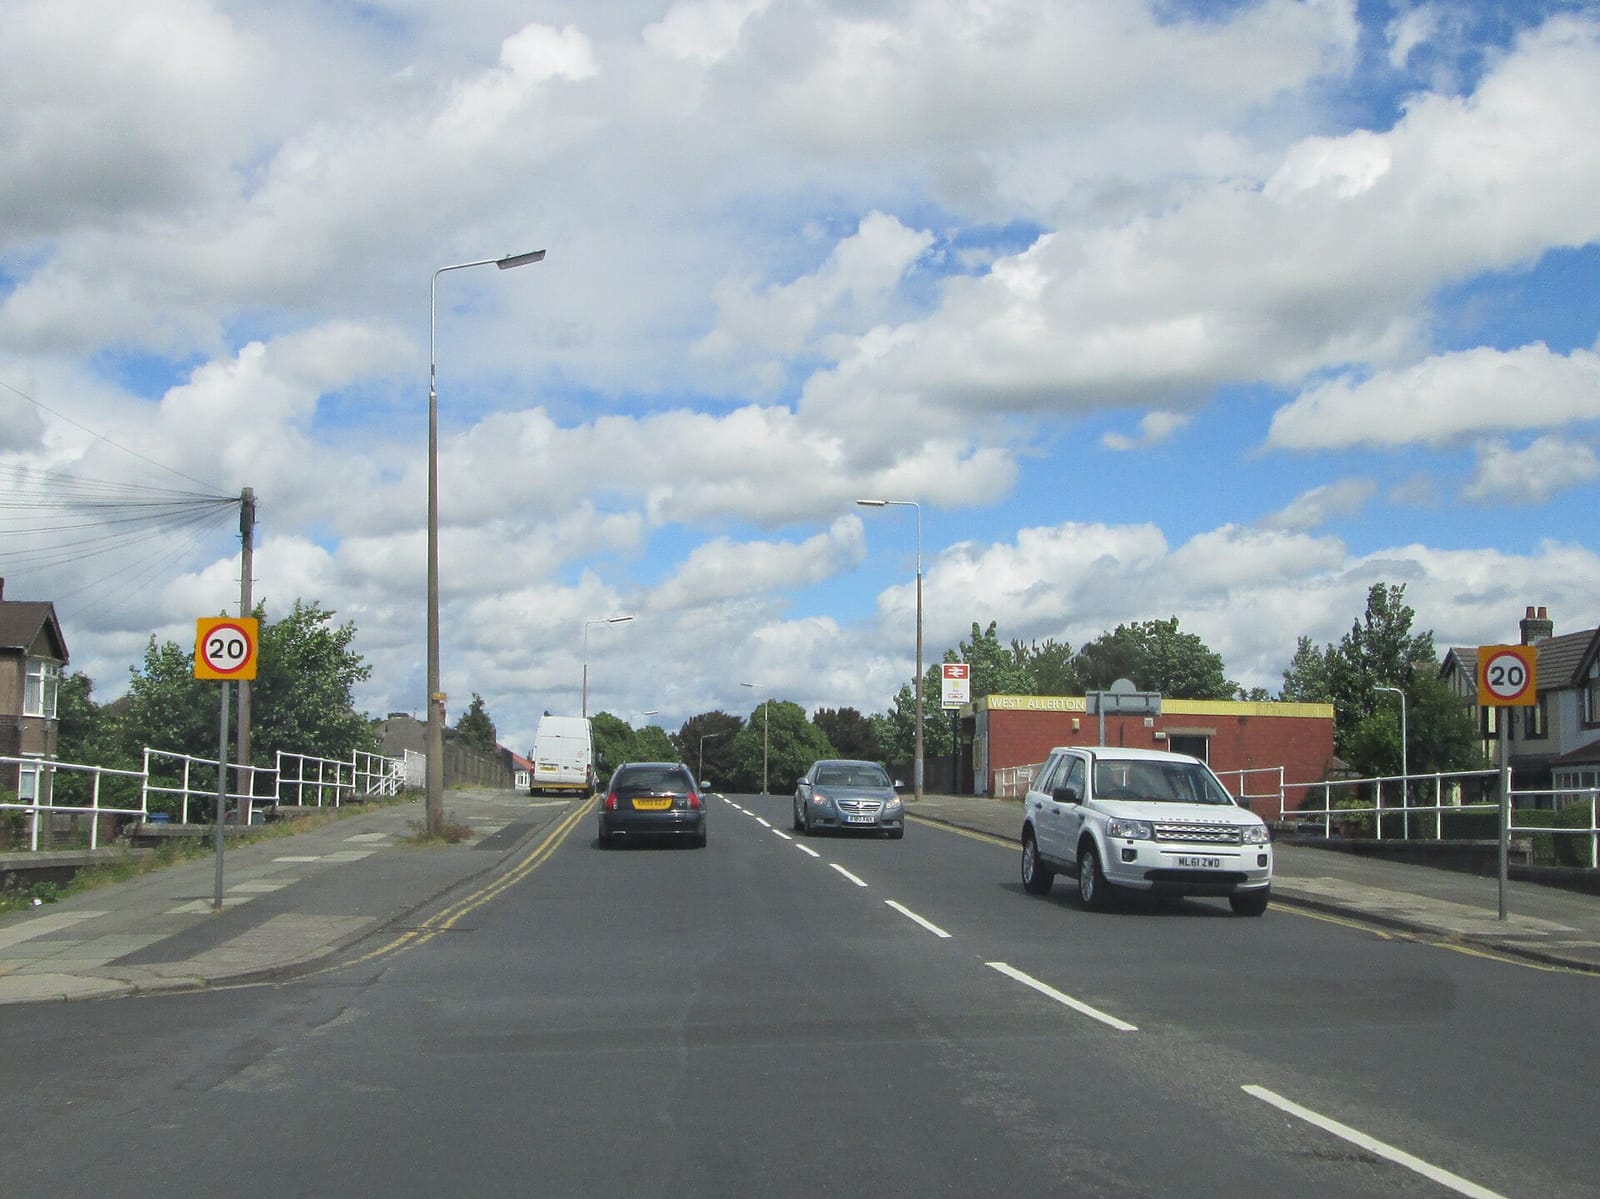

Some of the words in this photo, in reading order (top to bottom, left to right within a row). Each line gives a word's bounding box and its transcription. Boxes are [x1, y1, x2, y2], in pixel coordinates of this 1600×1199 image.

[209, 638, 244, 659] 20
[1490, 666, 1523, 686] 20
[991, 697, 1021, 708] WEST
[1029, 698, 1085, 710] ALLERTON
